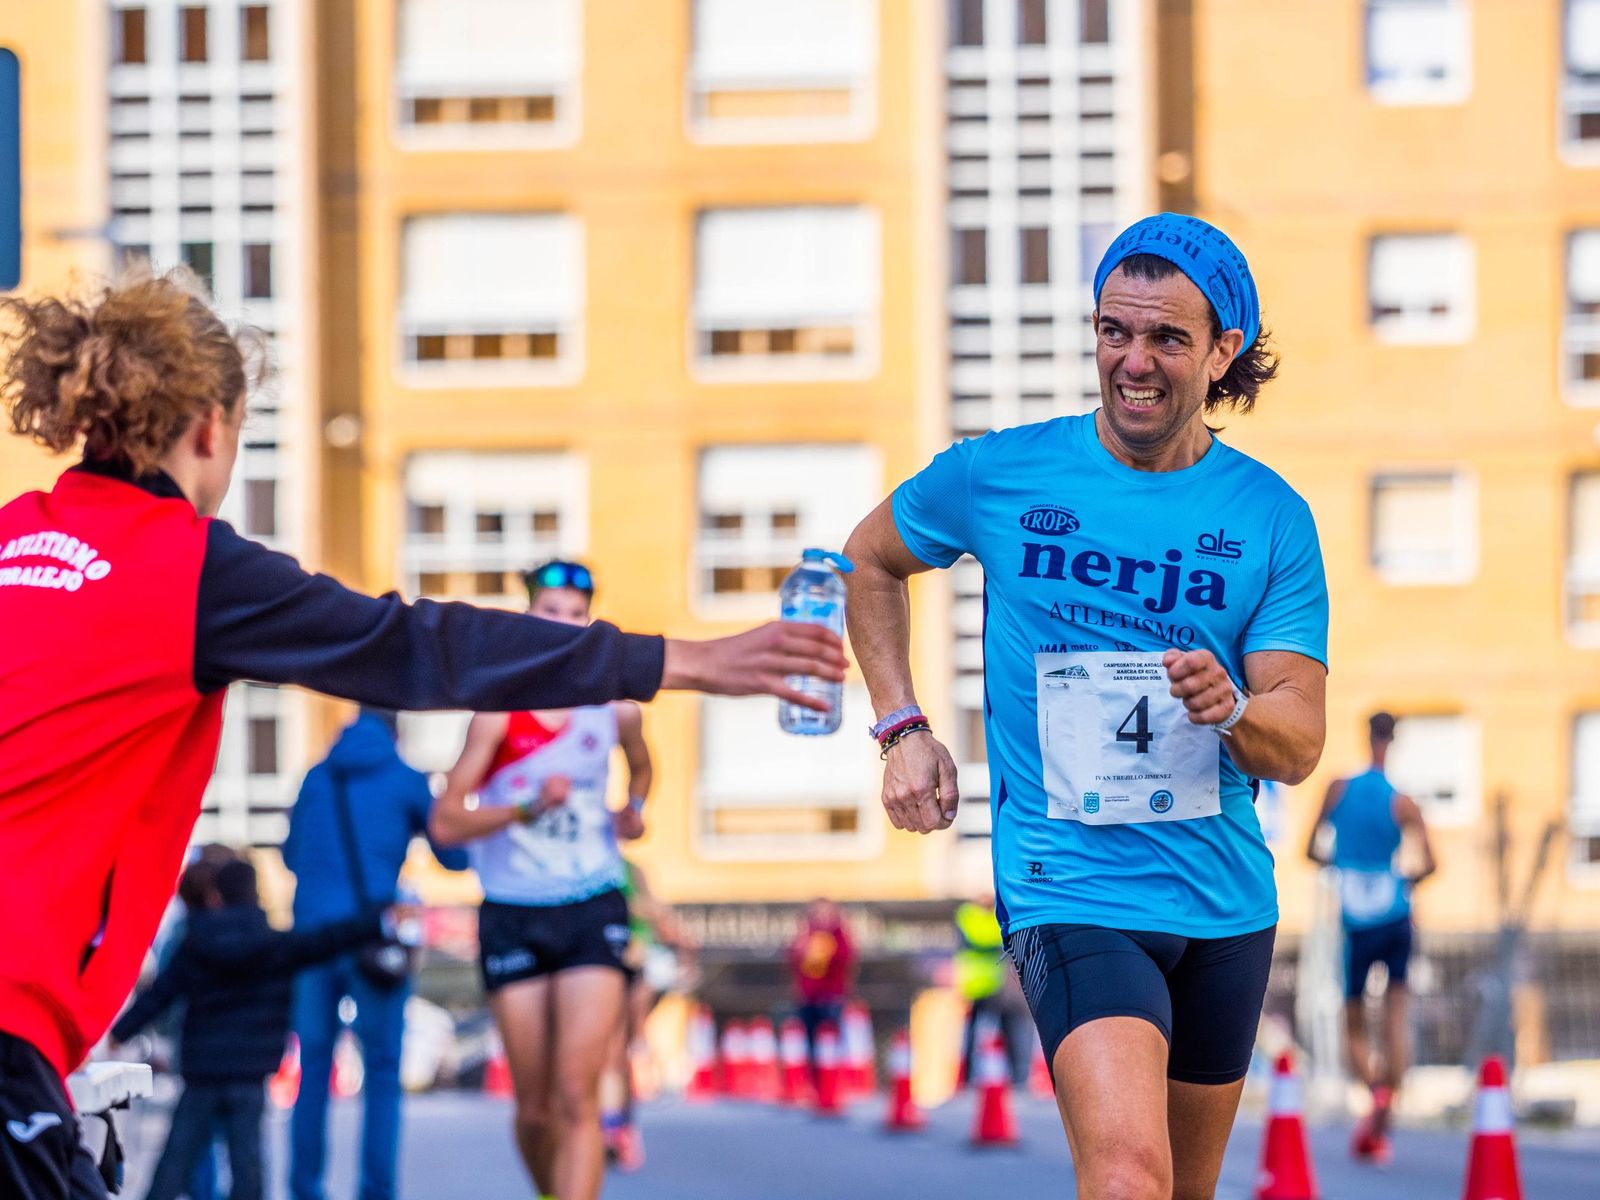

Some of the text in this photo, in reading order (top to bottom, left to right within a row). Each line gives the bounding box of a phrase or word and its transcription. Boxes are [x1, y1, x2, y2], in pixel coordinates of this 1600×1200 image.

[1023, 511, 1077, 532] TROPS
[1195, 528, 1242, 559] als
[1018, 542, 1227, 614] nerja
[1049, 601, 1195, 646] ATLETISMO
[1070, 643, 1099, 651] metro
[1116, 696, 1153, 753] 4
